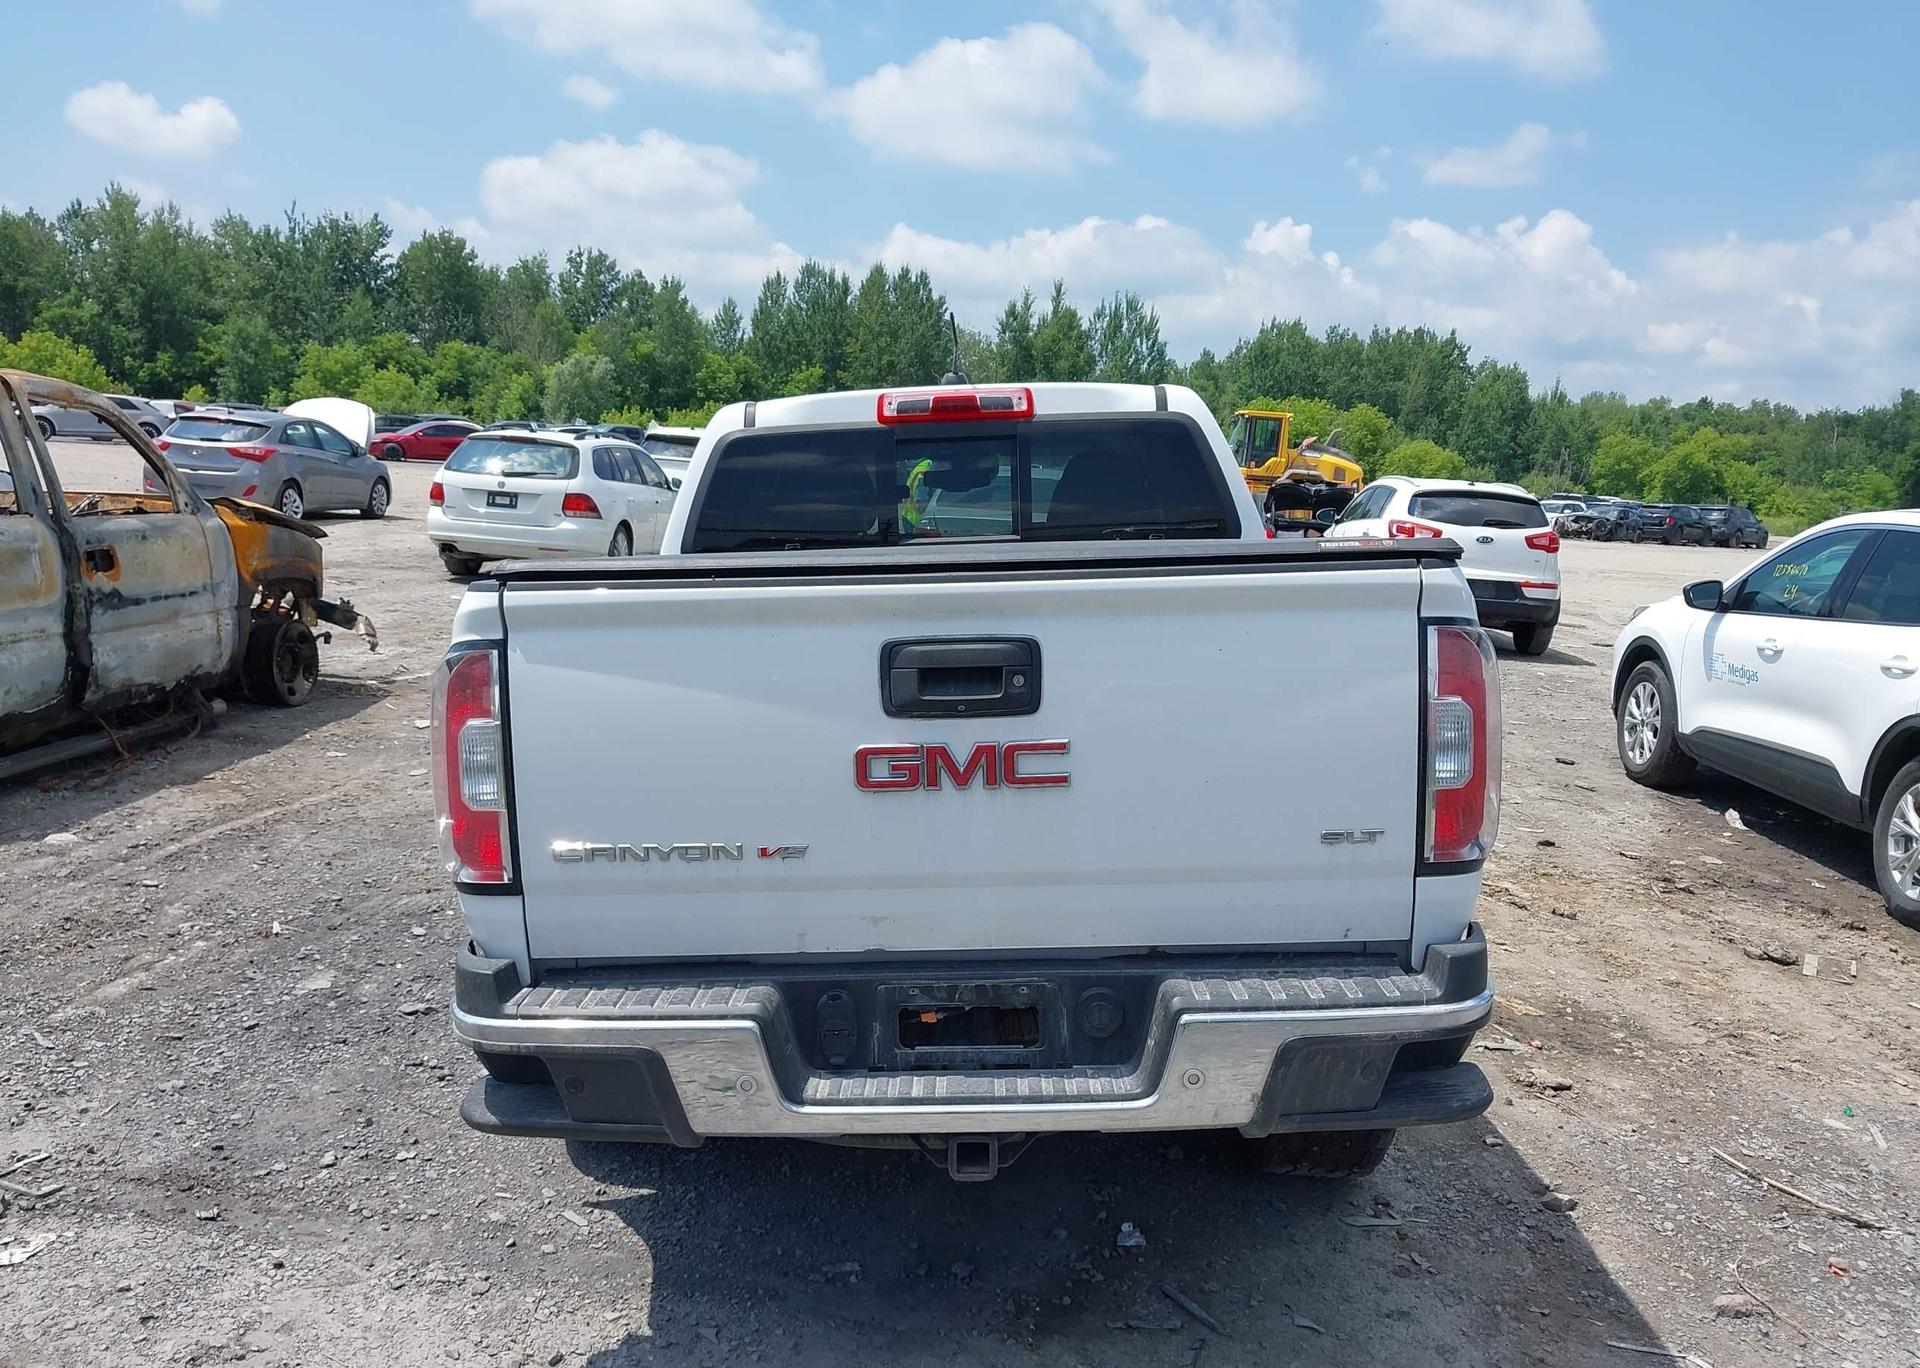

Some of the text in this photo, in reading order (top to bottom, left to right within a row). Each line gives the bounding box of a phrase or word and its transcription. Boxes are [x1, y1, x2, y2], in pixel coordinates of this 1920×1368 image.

[1784, 584, 1799, 600] 24
[1728, 662, 1759, 684] Medigas
[855, 738, 1071, 792] GMC
[1320, 829, 1385, 845] SLT
[552, 840, 743, 862] CANYON
